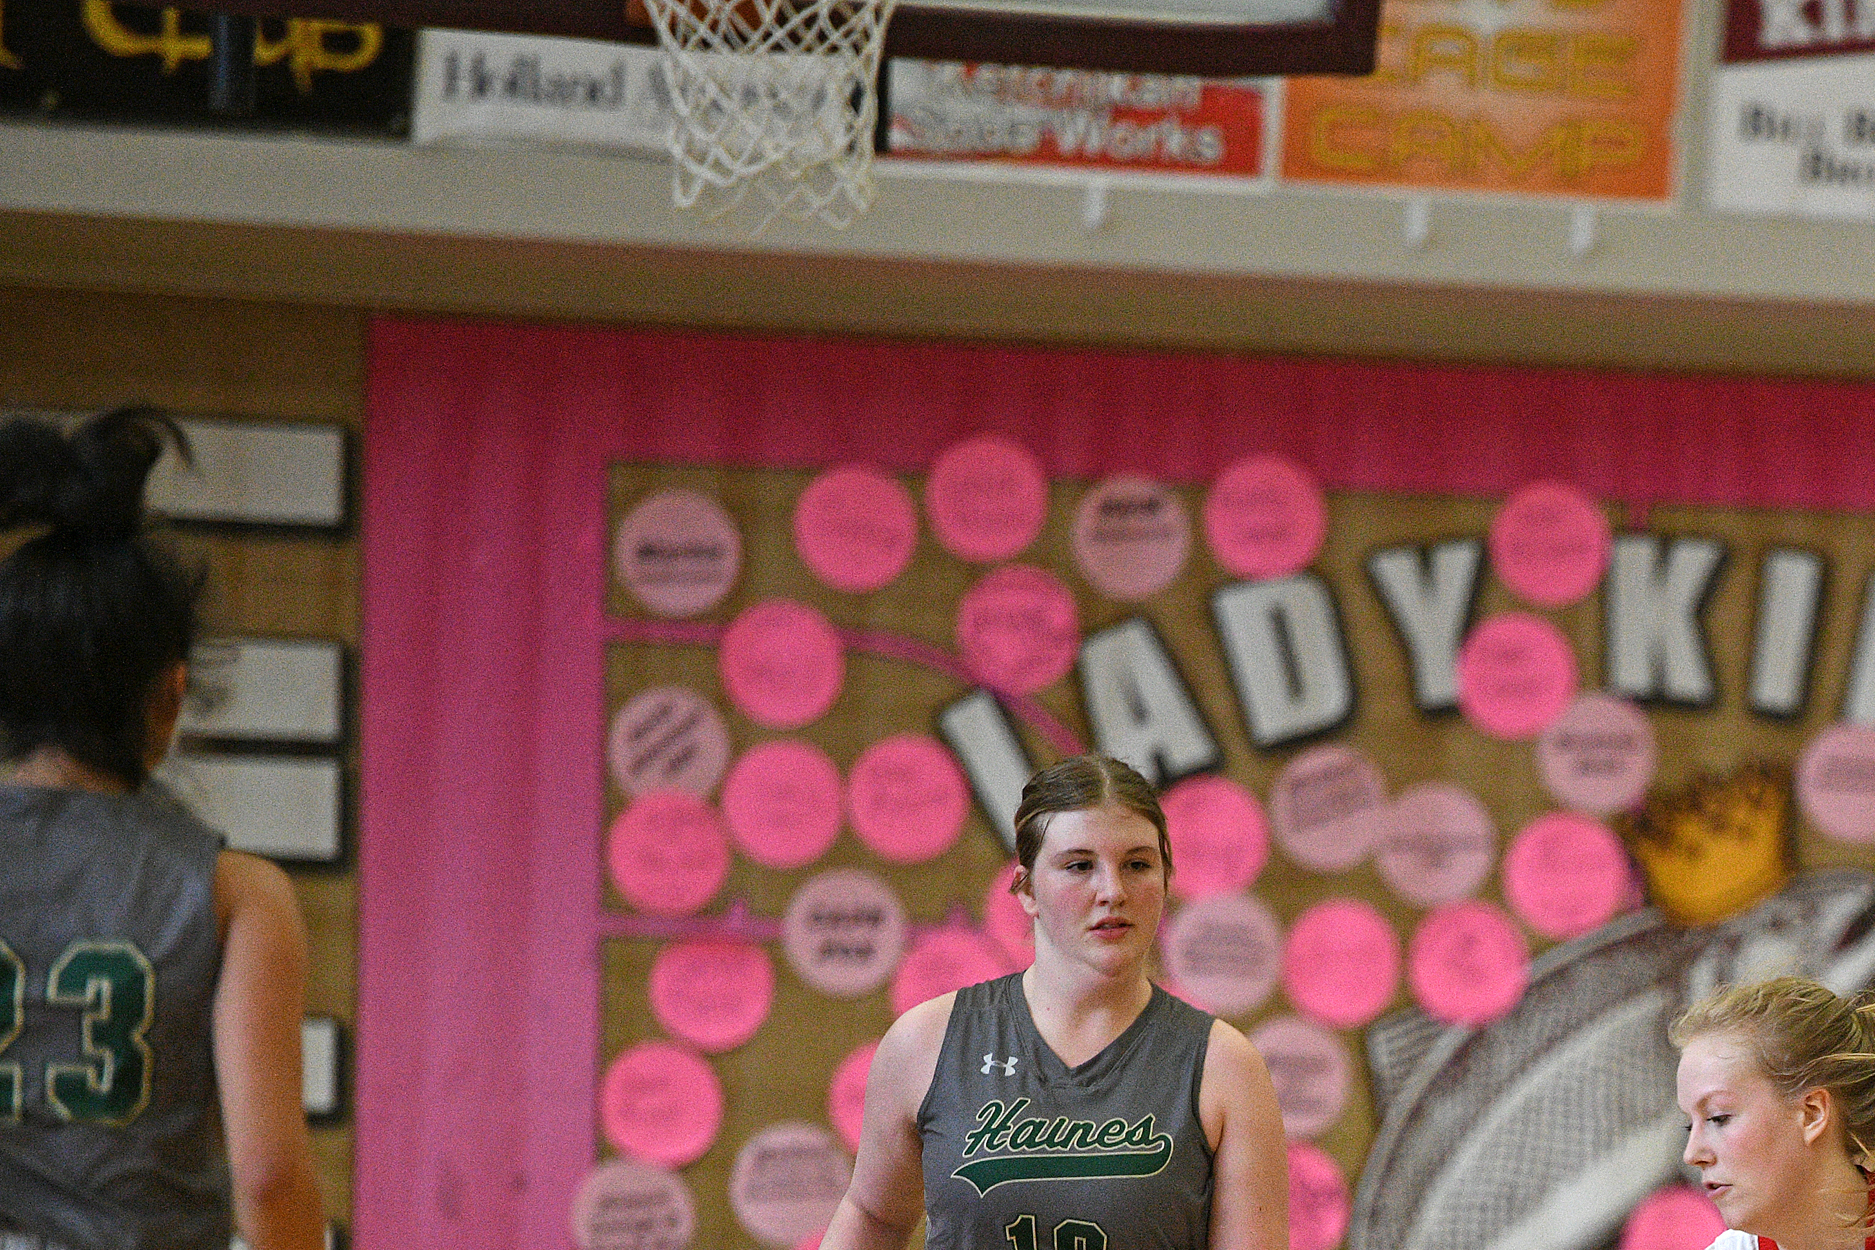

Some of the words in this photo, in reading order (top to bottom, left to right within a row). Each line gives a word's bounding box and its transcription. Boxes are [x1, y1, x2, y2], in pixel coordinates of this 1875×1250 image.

[440, 50, 627, 109] Holland
[1053, 107, 1224, 165] Works
[1312, 106, 1645, 182] CAMP
[0, 938, 155, 1128] 3
[960, 1097, 1172, 1160] Haines
